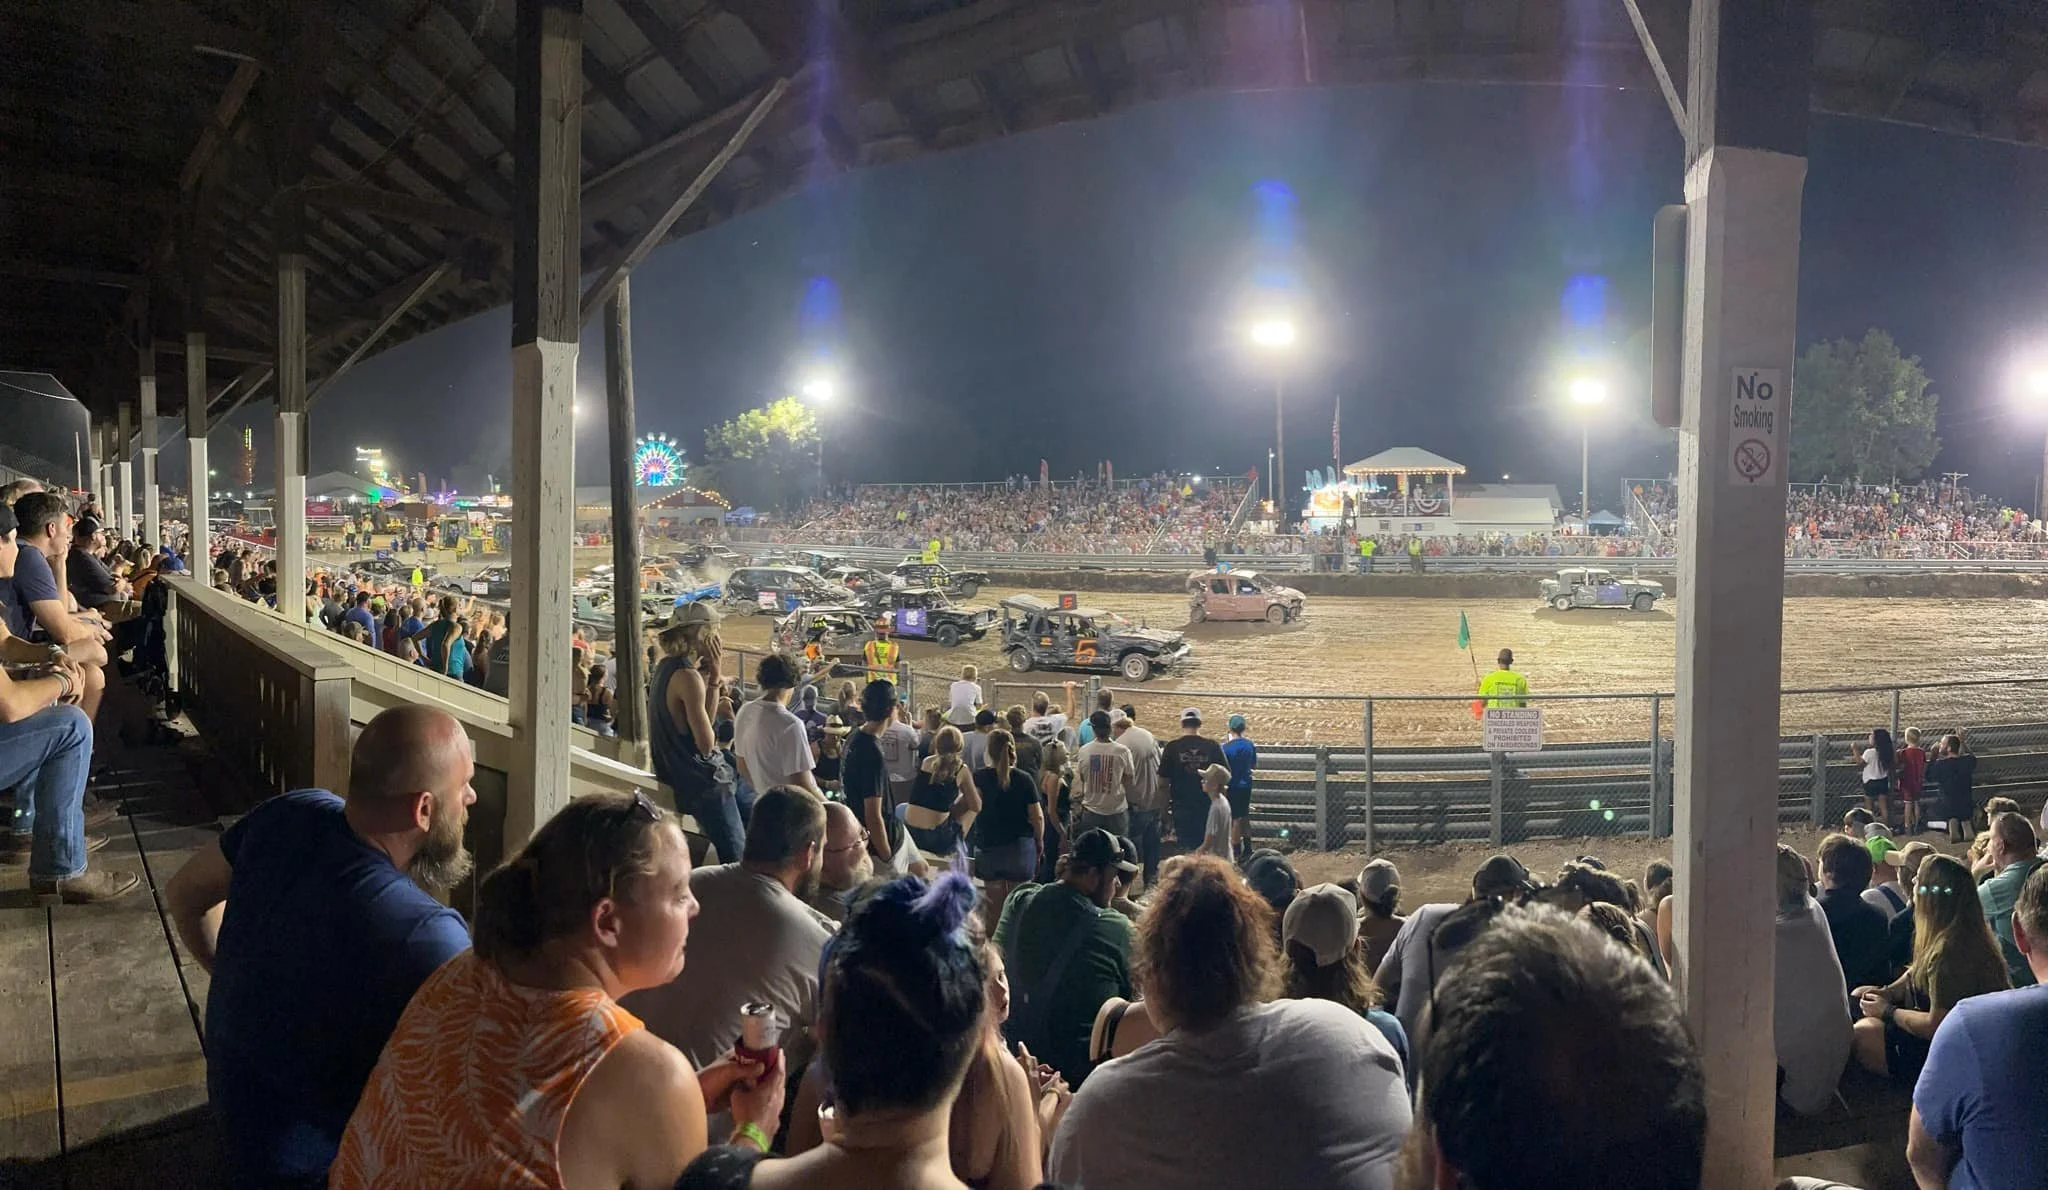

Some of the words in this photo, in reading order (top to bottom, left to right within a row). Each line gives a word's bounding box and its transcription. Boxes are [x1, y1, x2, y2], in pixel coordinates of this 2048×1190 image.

[1736, 375, 1773, 400] No
[1734, 405, 1774, 434] Smoking
[1075, 639, 1098, 665] 5
[1489, 711, 1500, 719] NO
[1501, 711, 1538, 719] STANDING
